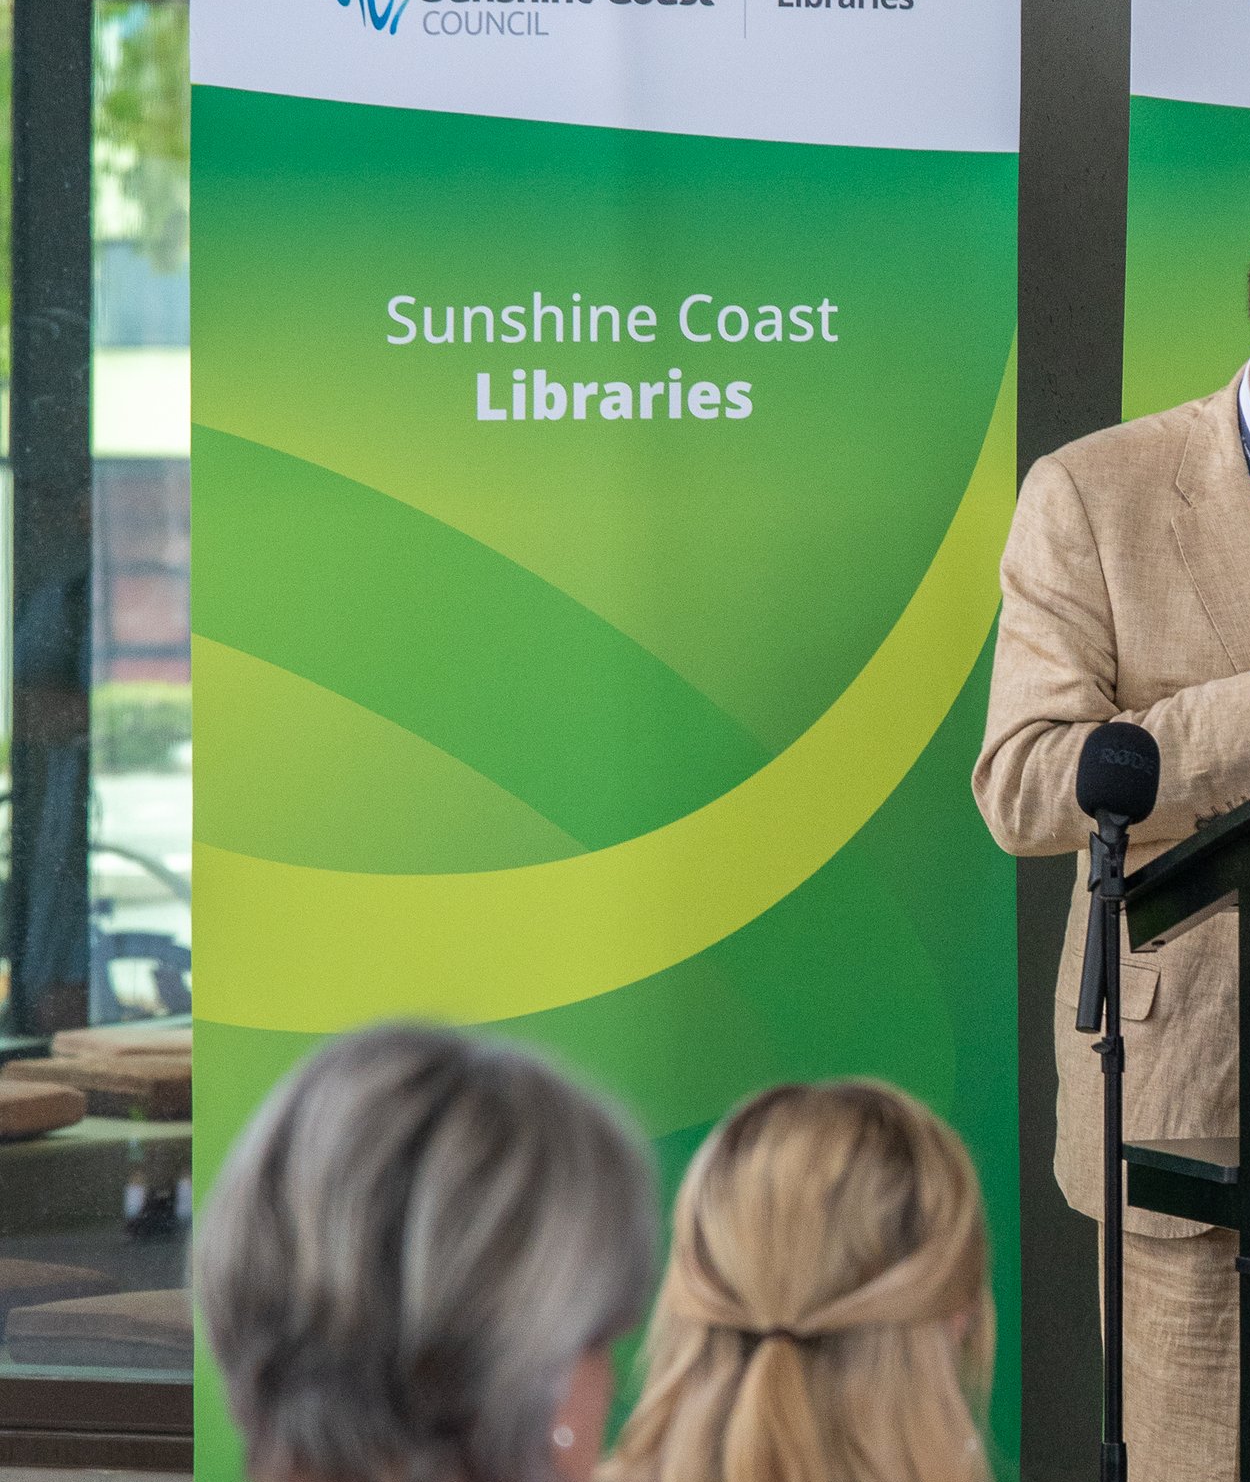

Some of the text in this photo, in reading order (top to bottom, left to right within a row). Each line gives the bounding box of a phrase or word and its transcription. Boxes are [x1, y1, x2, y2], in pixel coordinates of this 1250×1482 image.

[422, 10, 549, 36] COUNCIL
[386, 291, 839, 345] Sunshine Coast
[476, 367, 753, 421] Libraries
